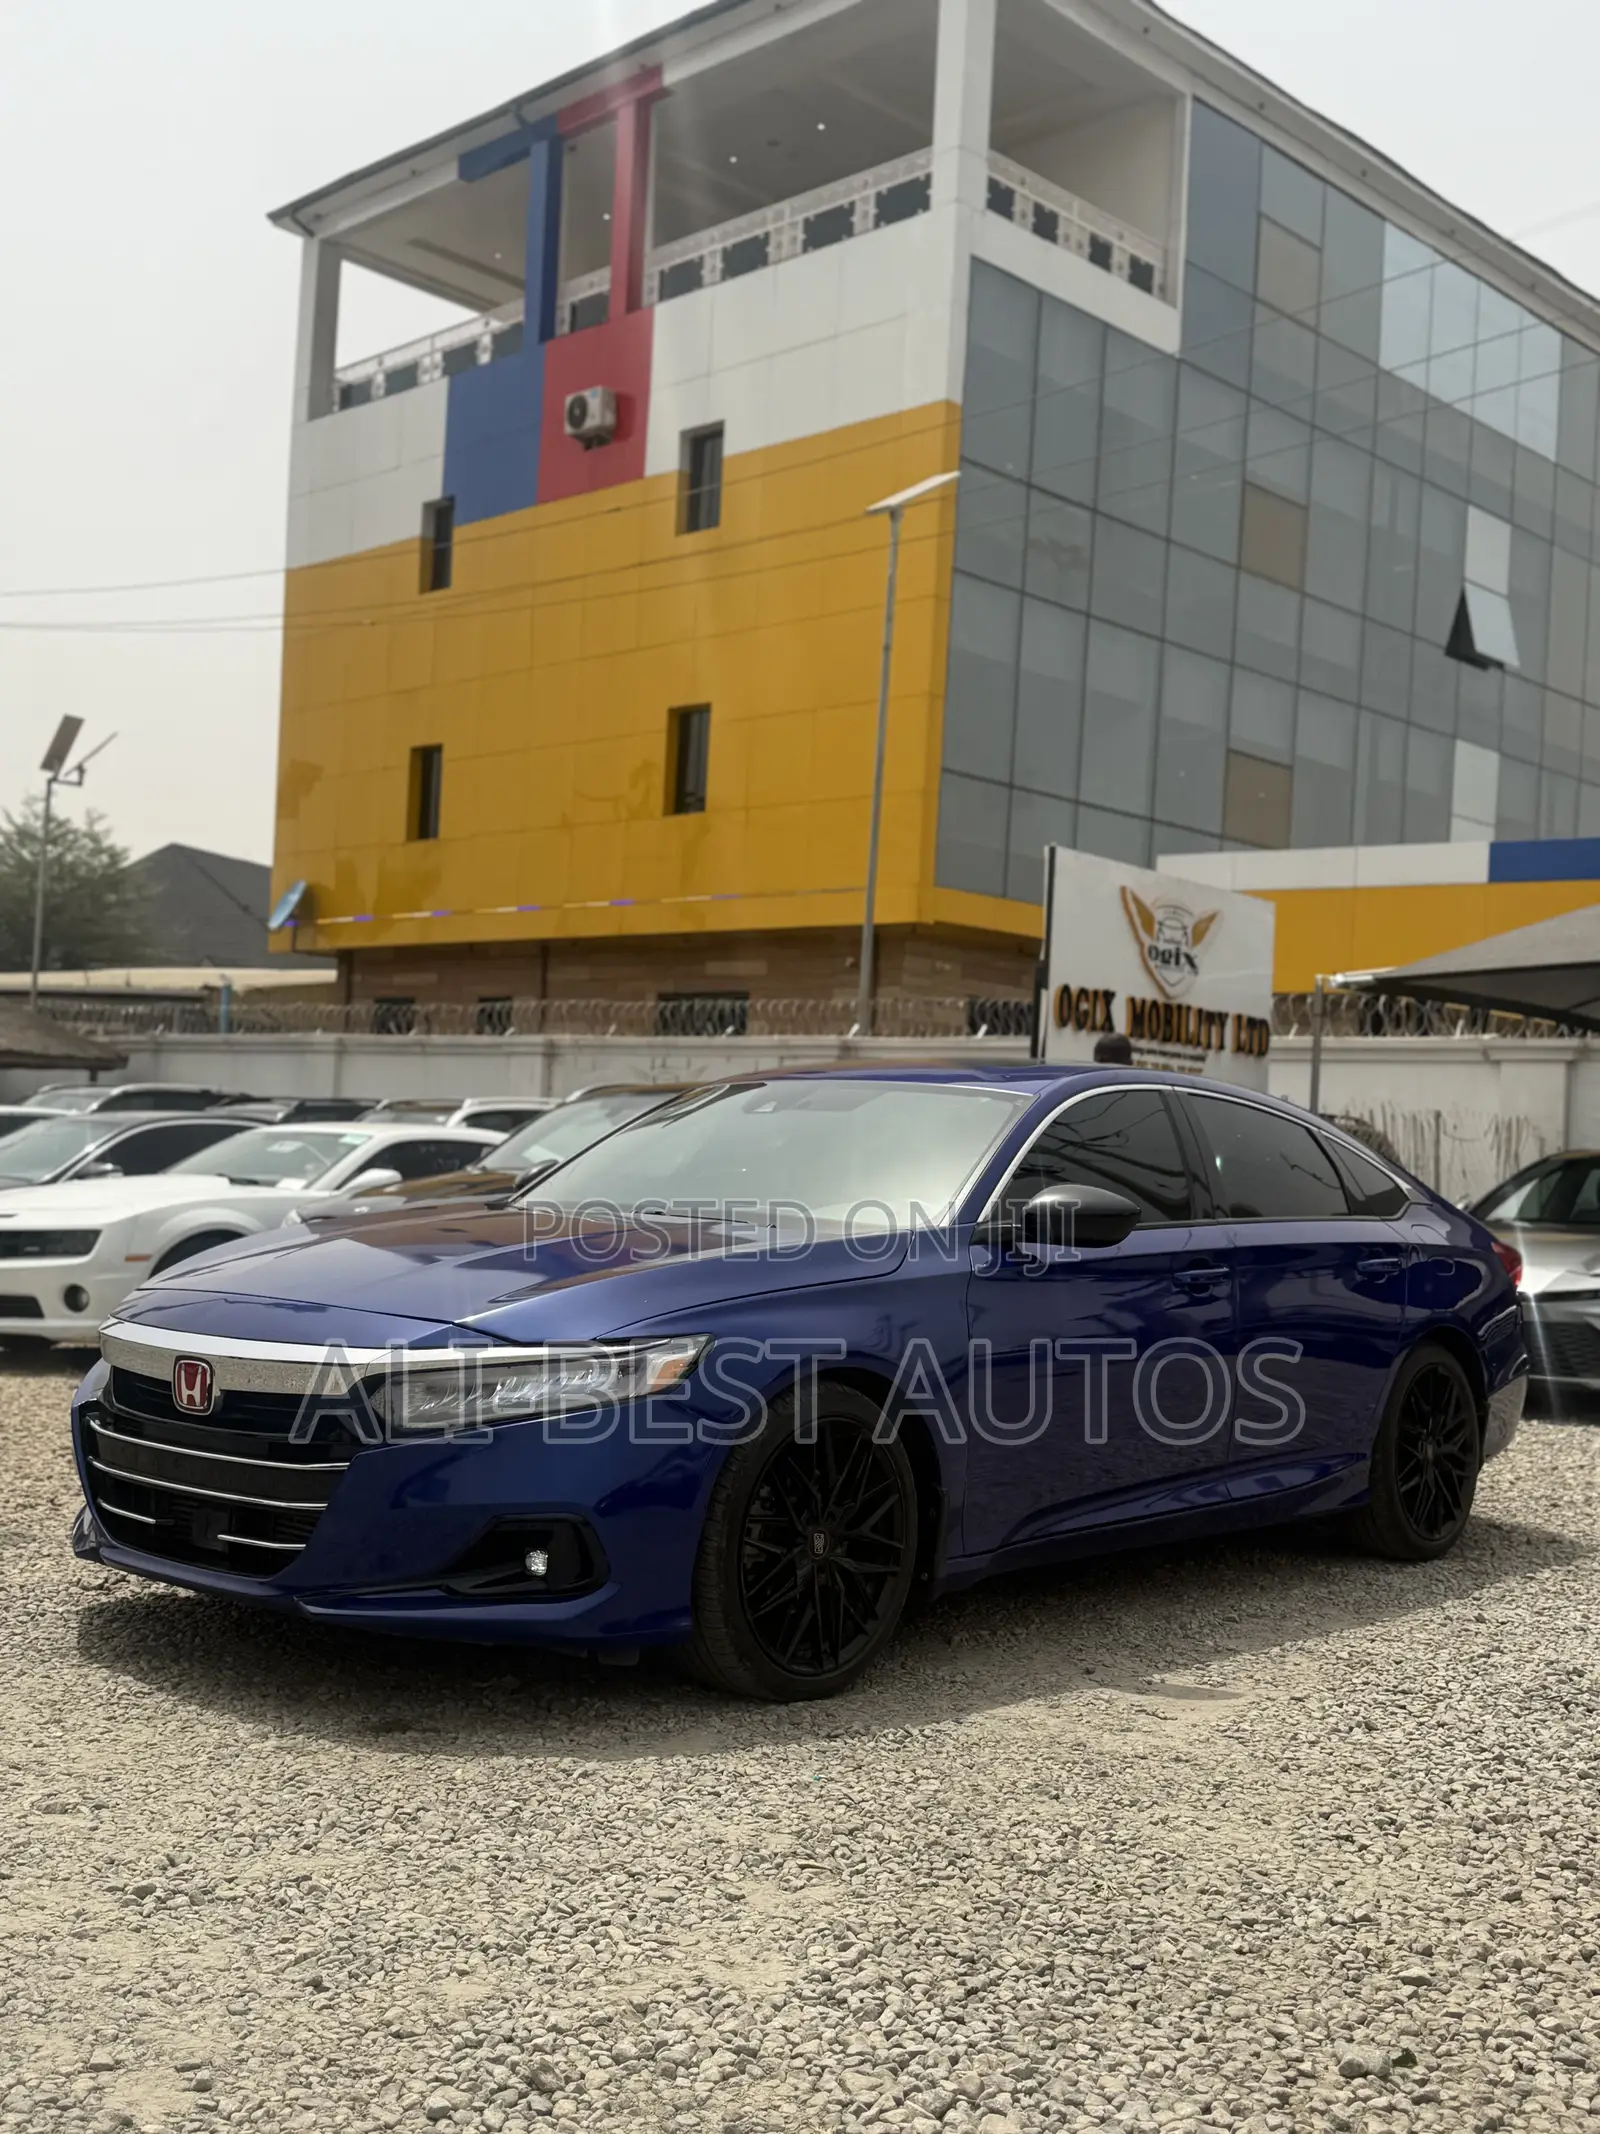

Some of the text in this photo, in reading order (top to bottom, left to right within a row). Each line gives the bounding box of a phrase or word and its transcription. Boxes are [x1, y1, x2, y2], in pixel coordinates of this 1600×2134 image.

[1053, 983, 1271, 1058] OGIX MOBILITY LTD
